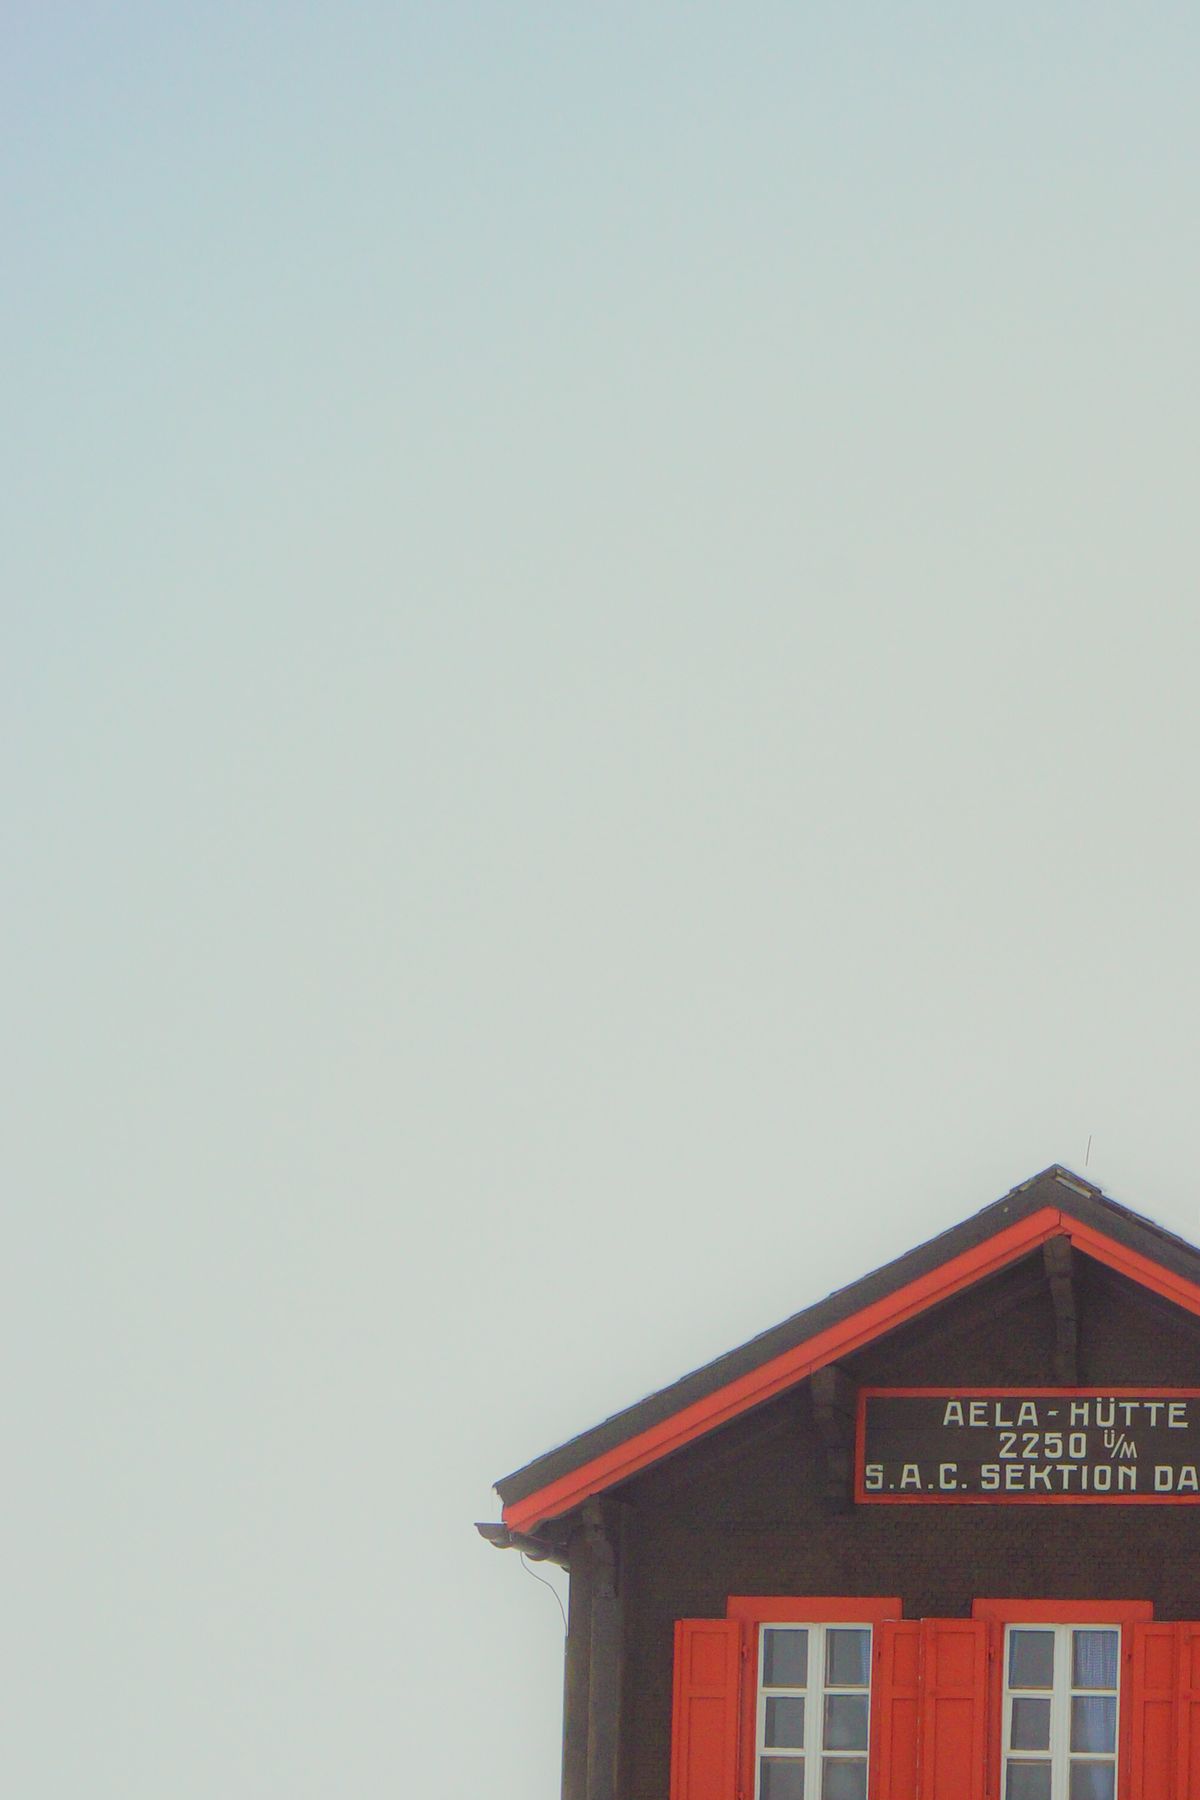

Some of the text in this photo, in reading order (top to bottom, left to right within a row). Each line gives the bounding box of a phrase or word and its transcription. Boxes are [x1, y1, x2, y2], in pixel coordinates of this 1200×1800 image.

[999, 1432, 1088, 1459] 2250
[865, 1463, 968, 1491] S.A.C.
[980, 1464, 1137, 1492] SEKTION
